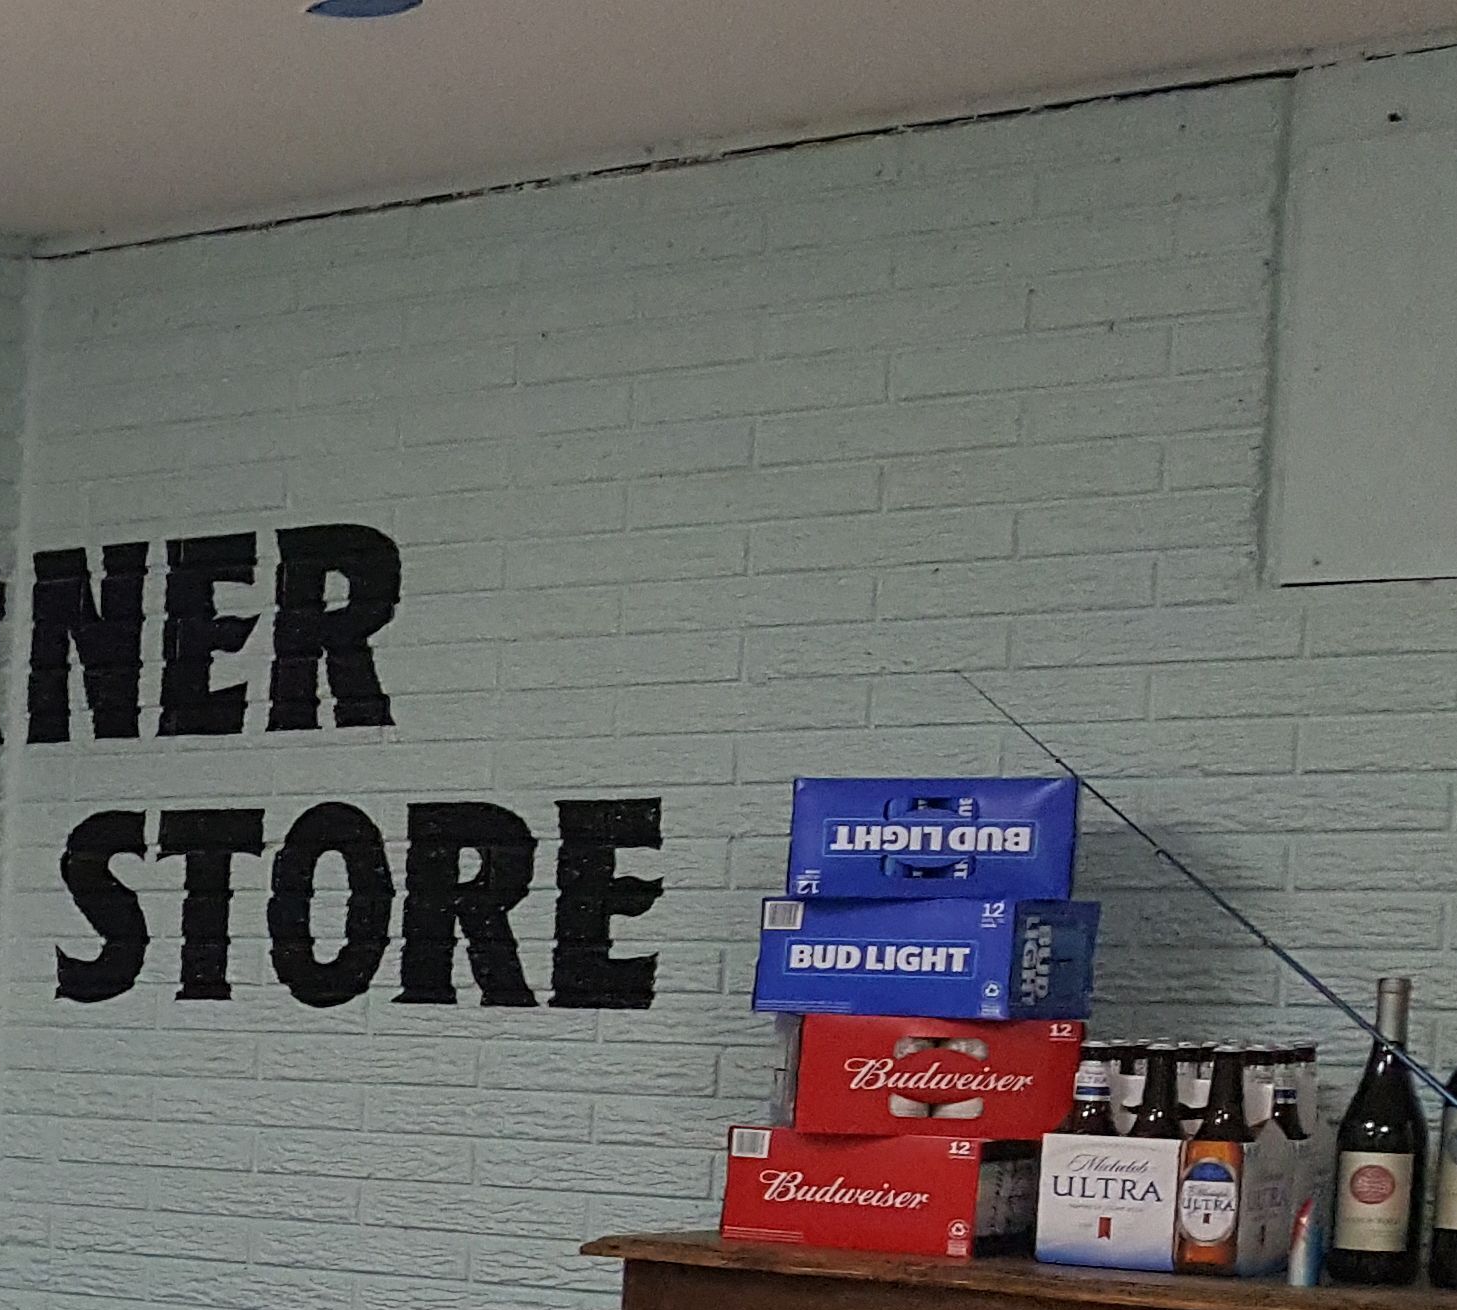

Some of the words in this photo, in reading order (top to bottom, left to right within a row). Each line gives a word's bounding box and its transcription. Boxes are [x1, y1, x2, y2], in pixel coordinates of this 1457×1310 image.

[830, 825, 943, 852] LIGHT
[948, 826, 1032, 852] BUD
[54, 797, 665, 1010] STORE
[982, 902, 1005, 918] 12
[789, 944, 862, 970] BUD
[865, 945, 971, 973] LIGHT
[1048, 1023, 1073, 1037] 12
[844, 1057, 1034, 1092] Budweiser
[948, 1141, 971, 1155] 12
[759, 1169, 930, 1210] Budweiser
[1052, 1175, 1163, 1202] ULTRA
